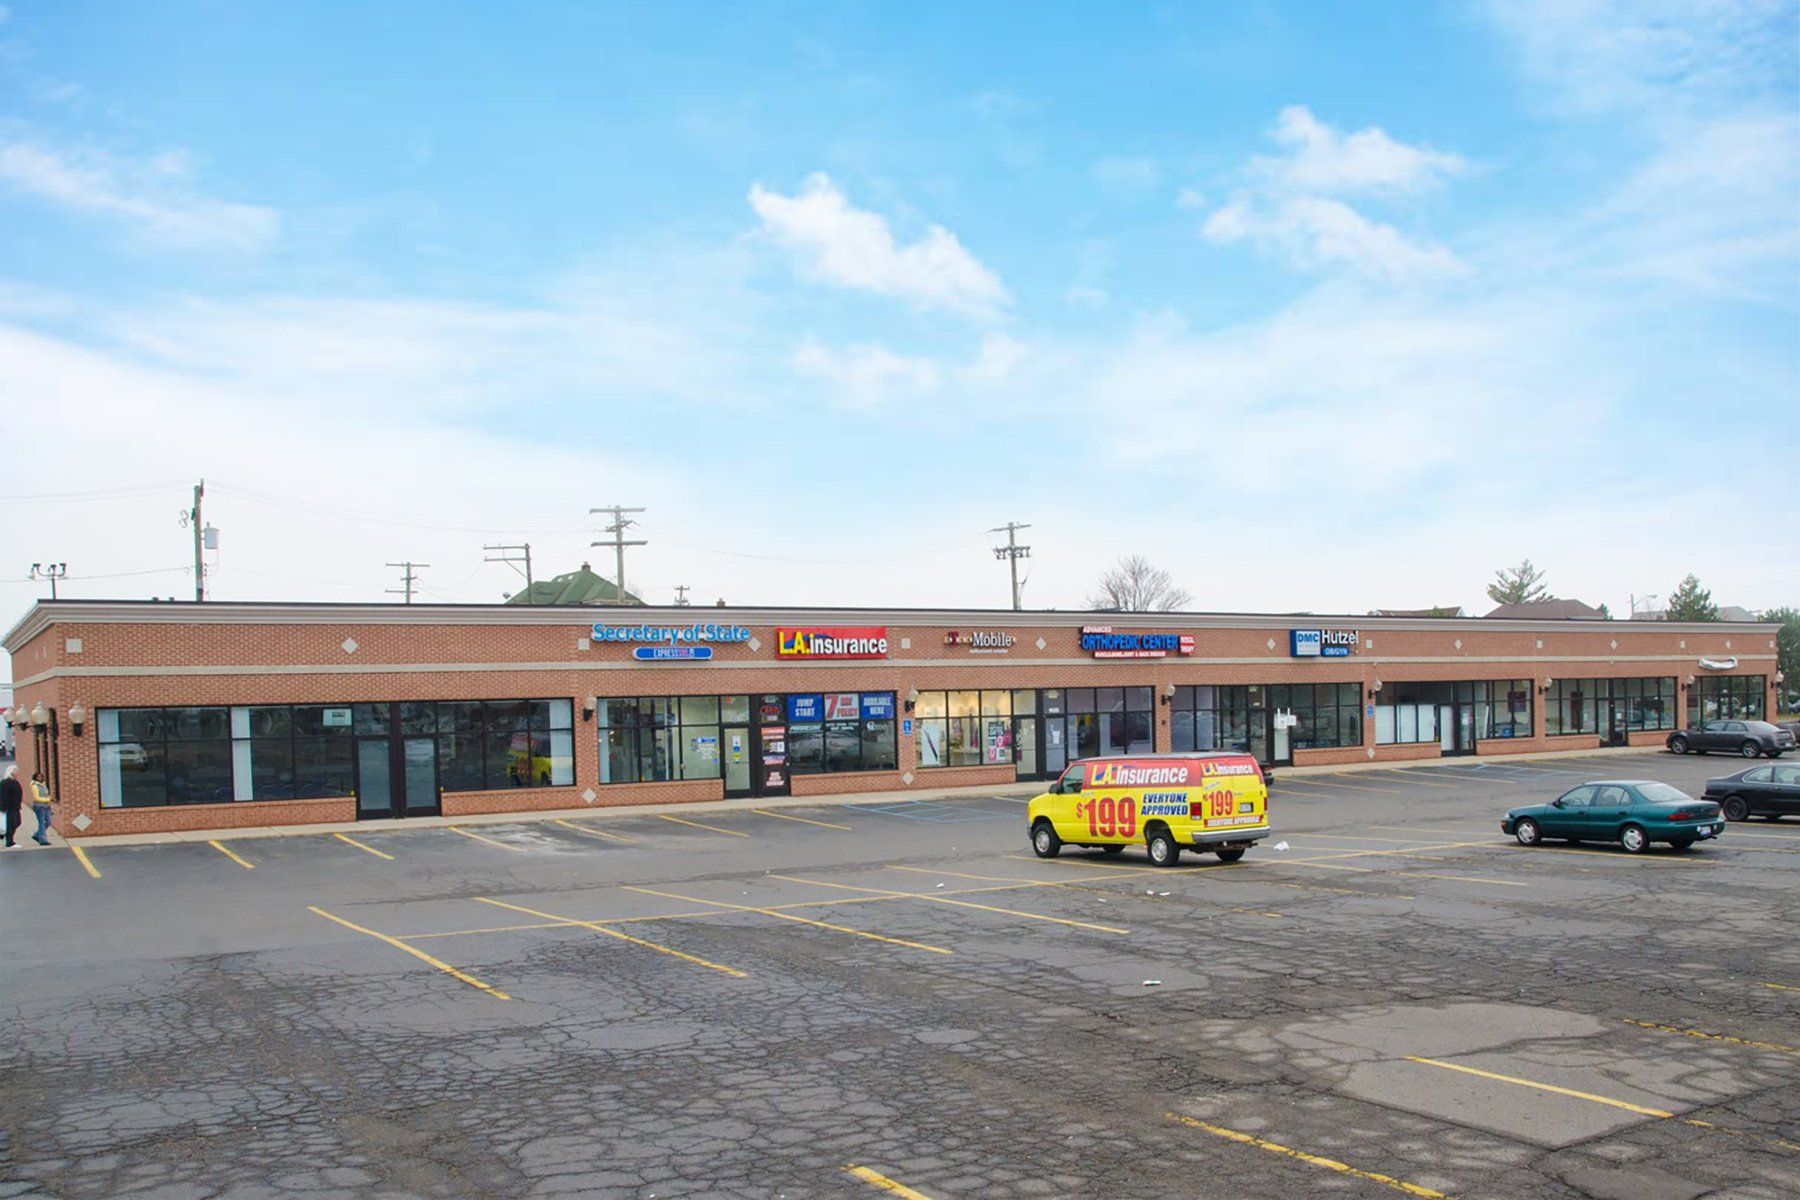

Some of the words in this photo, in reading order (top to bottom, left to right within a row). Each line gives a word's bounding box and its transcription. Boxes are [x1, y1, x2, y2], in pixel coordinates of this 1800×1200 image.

[593, 623, 681, 645] Secretary
[683, 624, 700, 642] of
[705, 624, 750, 642] State
[972, 631, 1013, 647] Mobile
[1082, 633, 1140, 651] ORTHOPEDIC
[1142, 634, 1178, 650] CENTER
[1296, 633, 1319, 643] DMC
[1321, 629, 1359, 645] Hutzel
[795, 707, 815, 717] START
[826, 694, 839, 718] 7
[1143, 792, 1188, 804] EVERYONE
[1140, 804, 1189, 816] APPROVED
